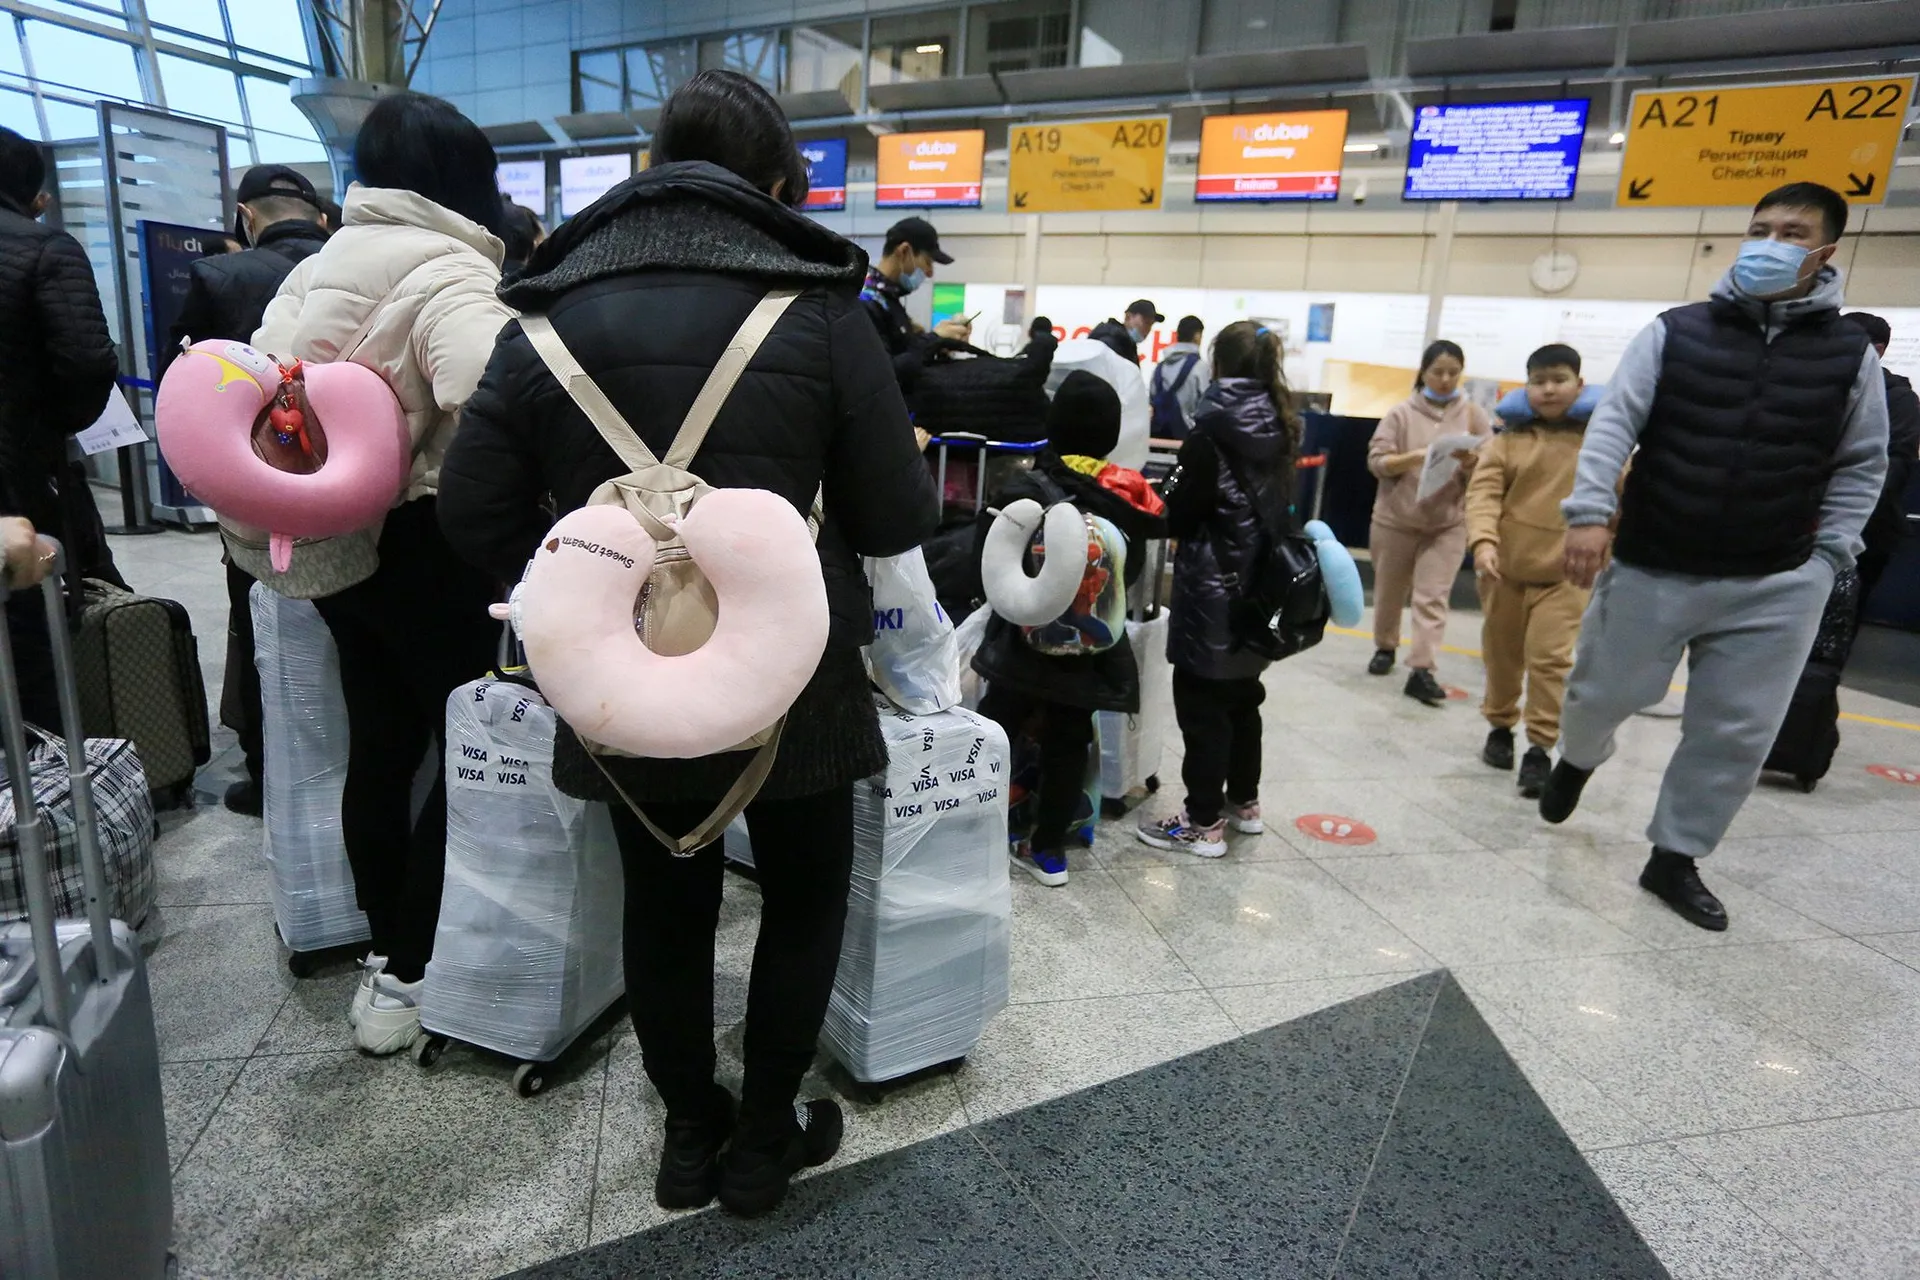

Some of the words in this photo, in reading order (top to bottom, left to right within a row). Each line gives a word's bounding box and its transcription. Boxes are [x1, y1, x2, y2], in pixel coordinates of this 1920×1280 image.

[1638, 95, 1719, 129] A21
[1804, 84, 1902, 122] A22
[1015, 128, 1061, 154] A19
[1111, 122, 1164, 149] A20
[1698, 148, 1808, 163] Регистрация
[1712, 165, 1787, 181] Check-in
[561, 536, 600, 554] Dream
[600, 547, 635, 569] Sweet
[511, 697, 533, 722] VISA
[921, 726, 934, 752] VISA
[461, 744, 488, 762] VISA
[966, 736, 985, 764] VISA
[499, 755, 529, 773] VISA
[456, 766, 485, 782] VISA
[497, 772, 527, 785] VISA
[950, 768, 975, 782] VISA
[870, 784, 893, 799] VISA
[911, 776, 939, 792] VISA
[977, 788, 997, 803] VISA
[894, 804, 923, 818] VISA
[933, 798, 960, 812] VISA
